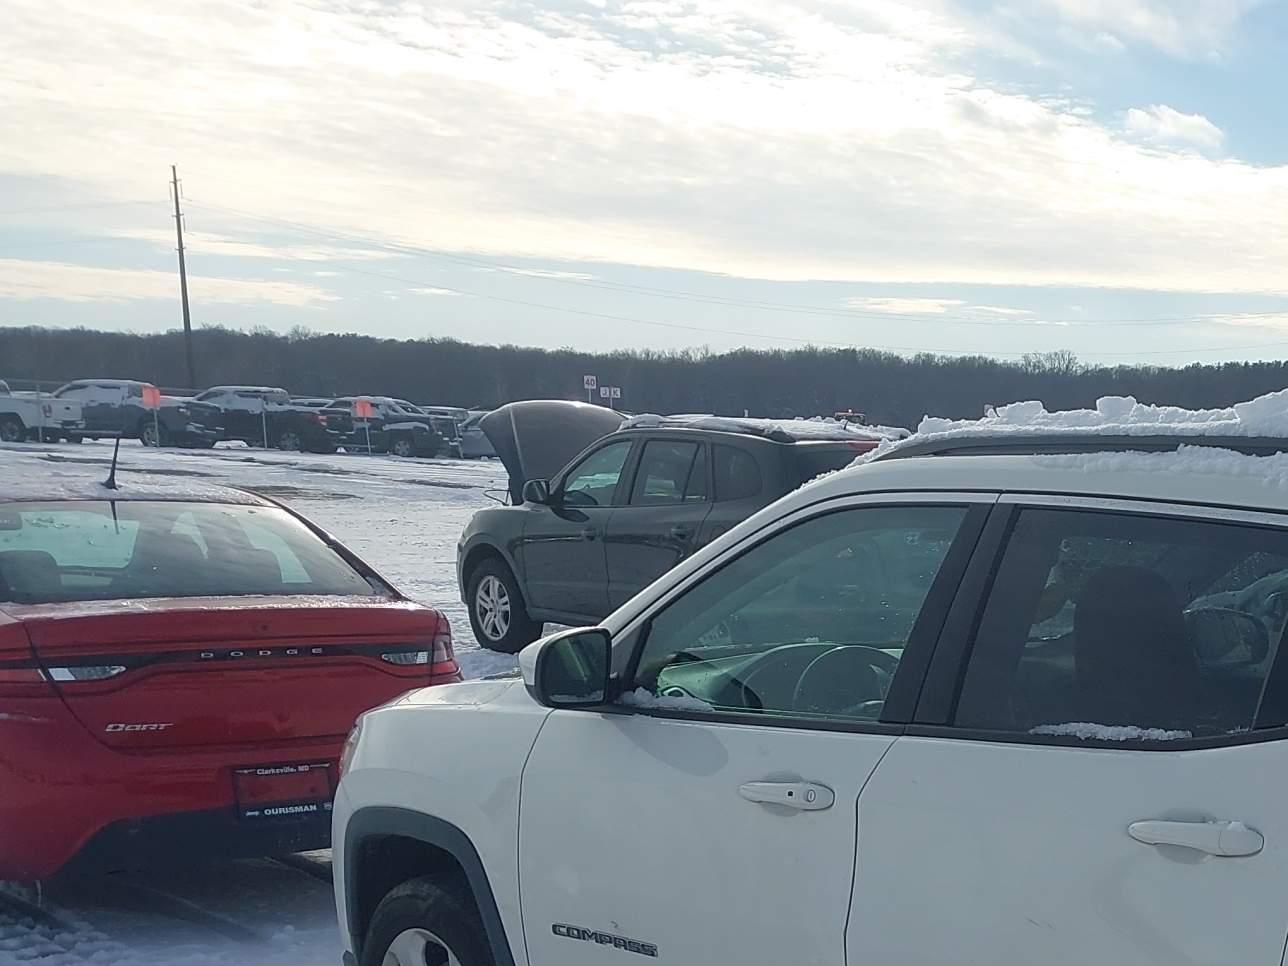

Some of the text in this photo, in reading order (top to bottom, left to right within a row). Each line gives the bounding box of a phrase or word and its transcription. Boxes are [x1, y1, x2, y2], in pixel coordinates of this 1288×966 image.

[585, 378, 596, 387] 40
[201, 647, 323, 659] DODGE
[264, 804, 317, 816] OURISMAN
[552, 923, 659, 957] COMPASS
